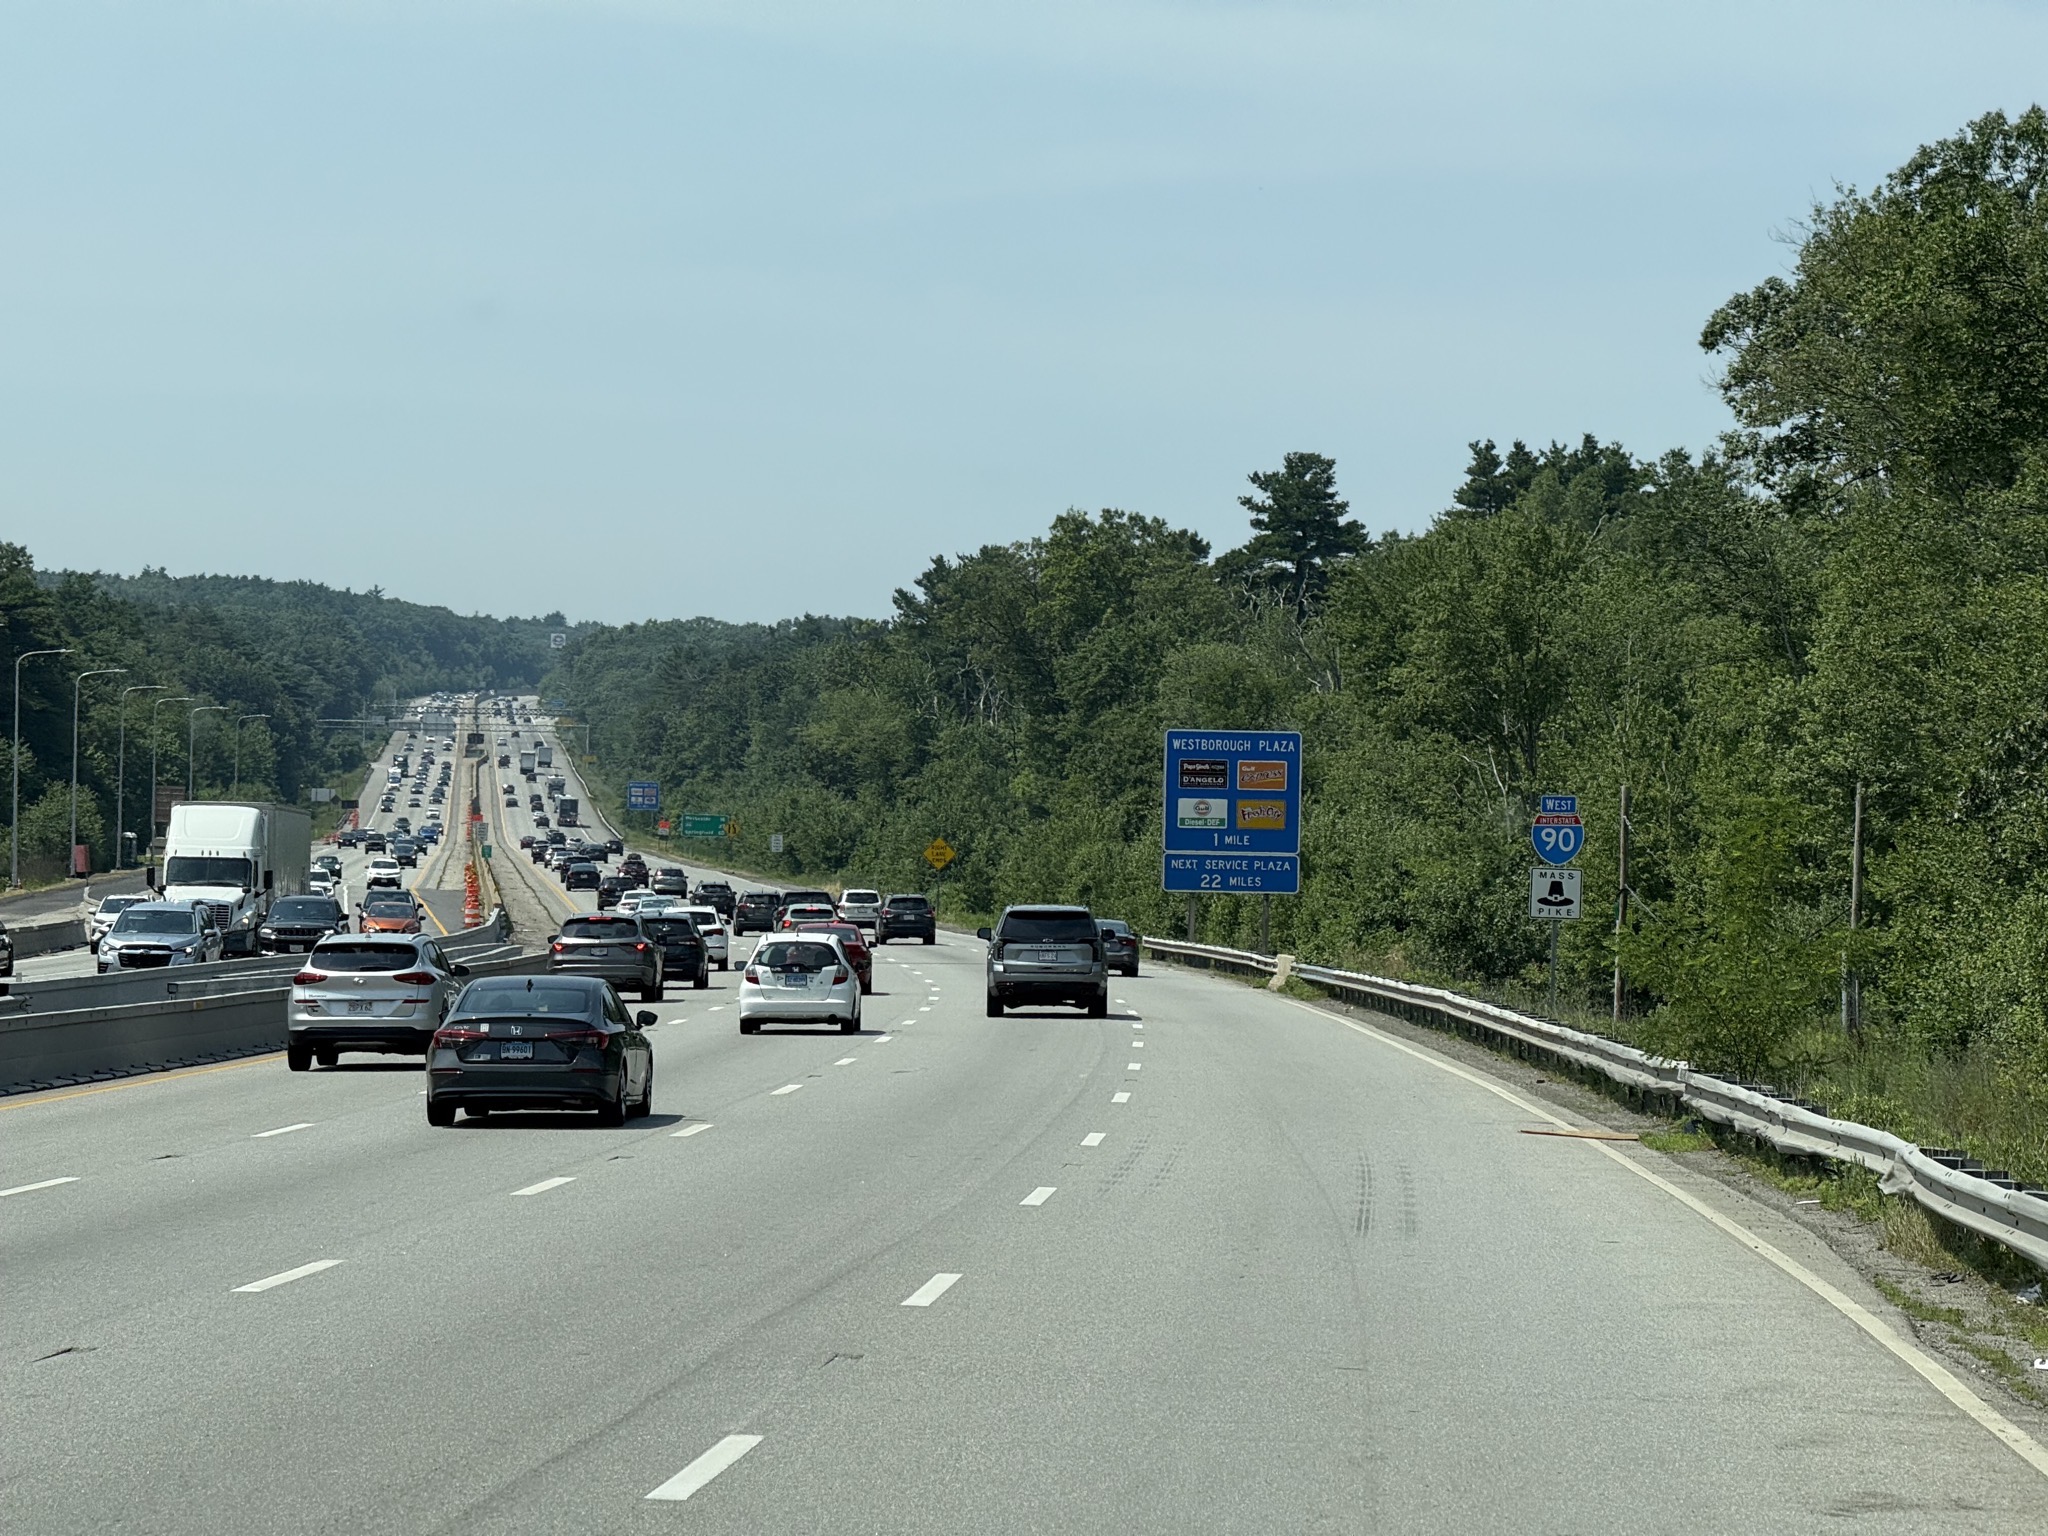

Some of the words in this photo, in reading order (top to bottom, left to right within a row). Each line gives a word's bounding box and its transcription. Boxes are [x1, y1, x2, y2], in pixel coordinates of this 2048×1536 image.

[1172, 738, 1251, 751] WESTBOROUGH
[1259, 740, 1295, 752] PLAZA
[1183, 775, 1224, 783] D'ANGELO
[1546, 799, 1572, 811] WEST
[1540, 817, 1576, 825] INTERSTATE
[1213, 833, 1218, 846] 1
[1224, 835, 1250, 846] MILE
[1541, 828, 1575, 852] 90
[1171, 859, 1198, 869] NEXT
[1204, 859, 1249, 871] SERVICE
[1254, 860, 1291, 871] PLAZA
[1200, 874, 1222, 888] 22
[1229, 876, 1262, 887] MILES
[1540, 871, 1573, 880] MASS
[1539, 908, 1573, 916] PIKE
